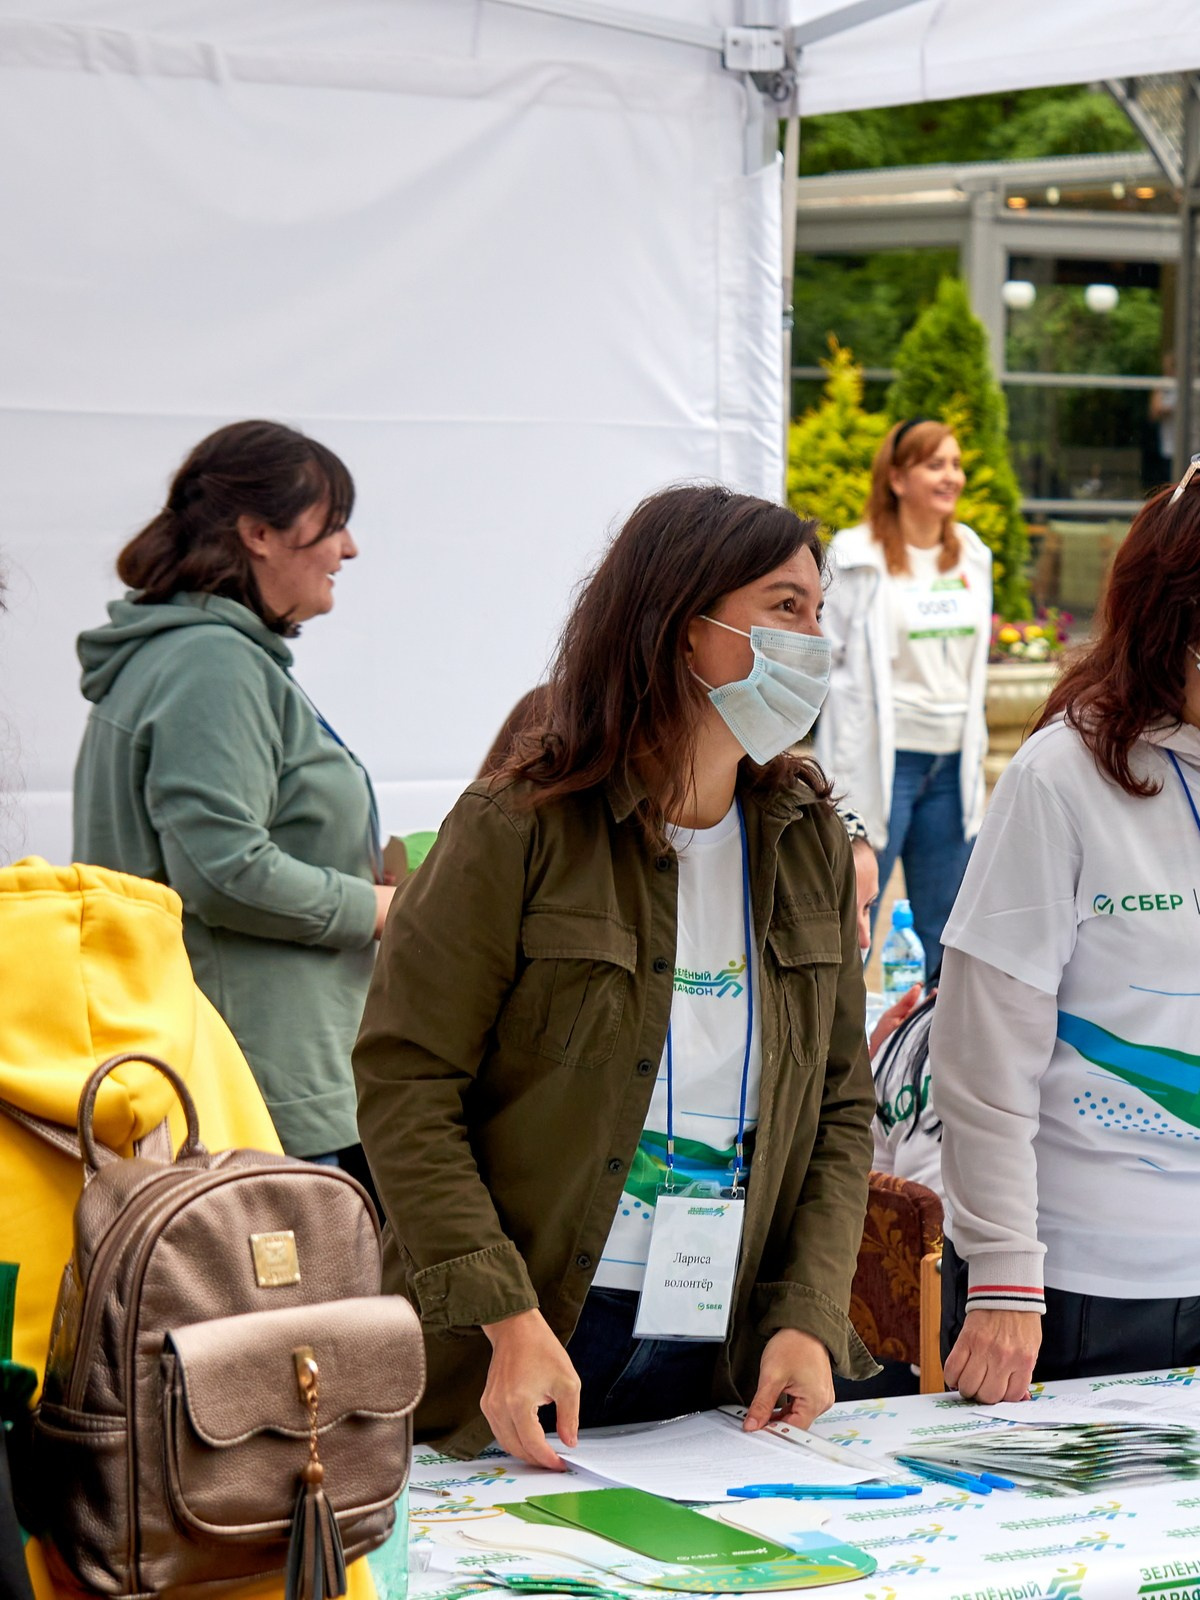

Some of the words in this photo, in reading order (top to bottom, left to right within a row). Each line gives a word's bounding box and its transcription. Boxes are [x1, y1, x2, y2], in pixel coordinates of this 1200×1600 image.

[1121, 894, 1183, 911] СБЕР
[672, 1252, 711, 1266] Лариса
[664, 1278, 713, 1291] волонтёр
